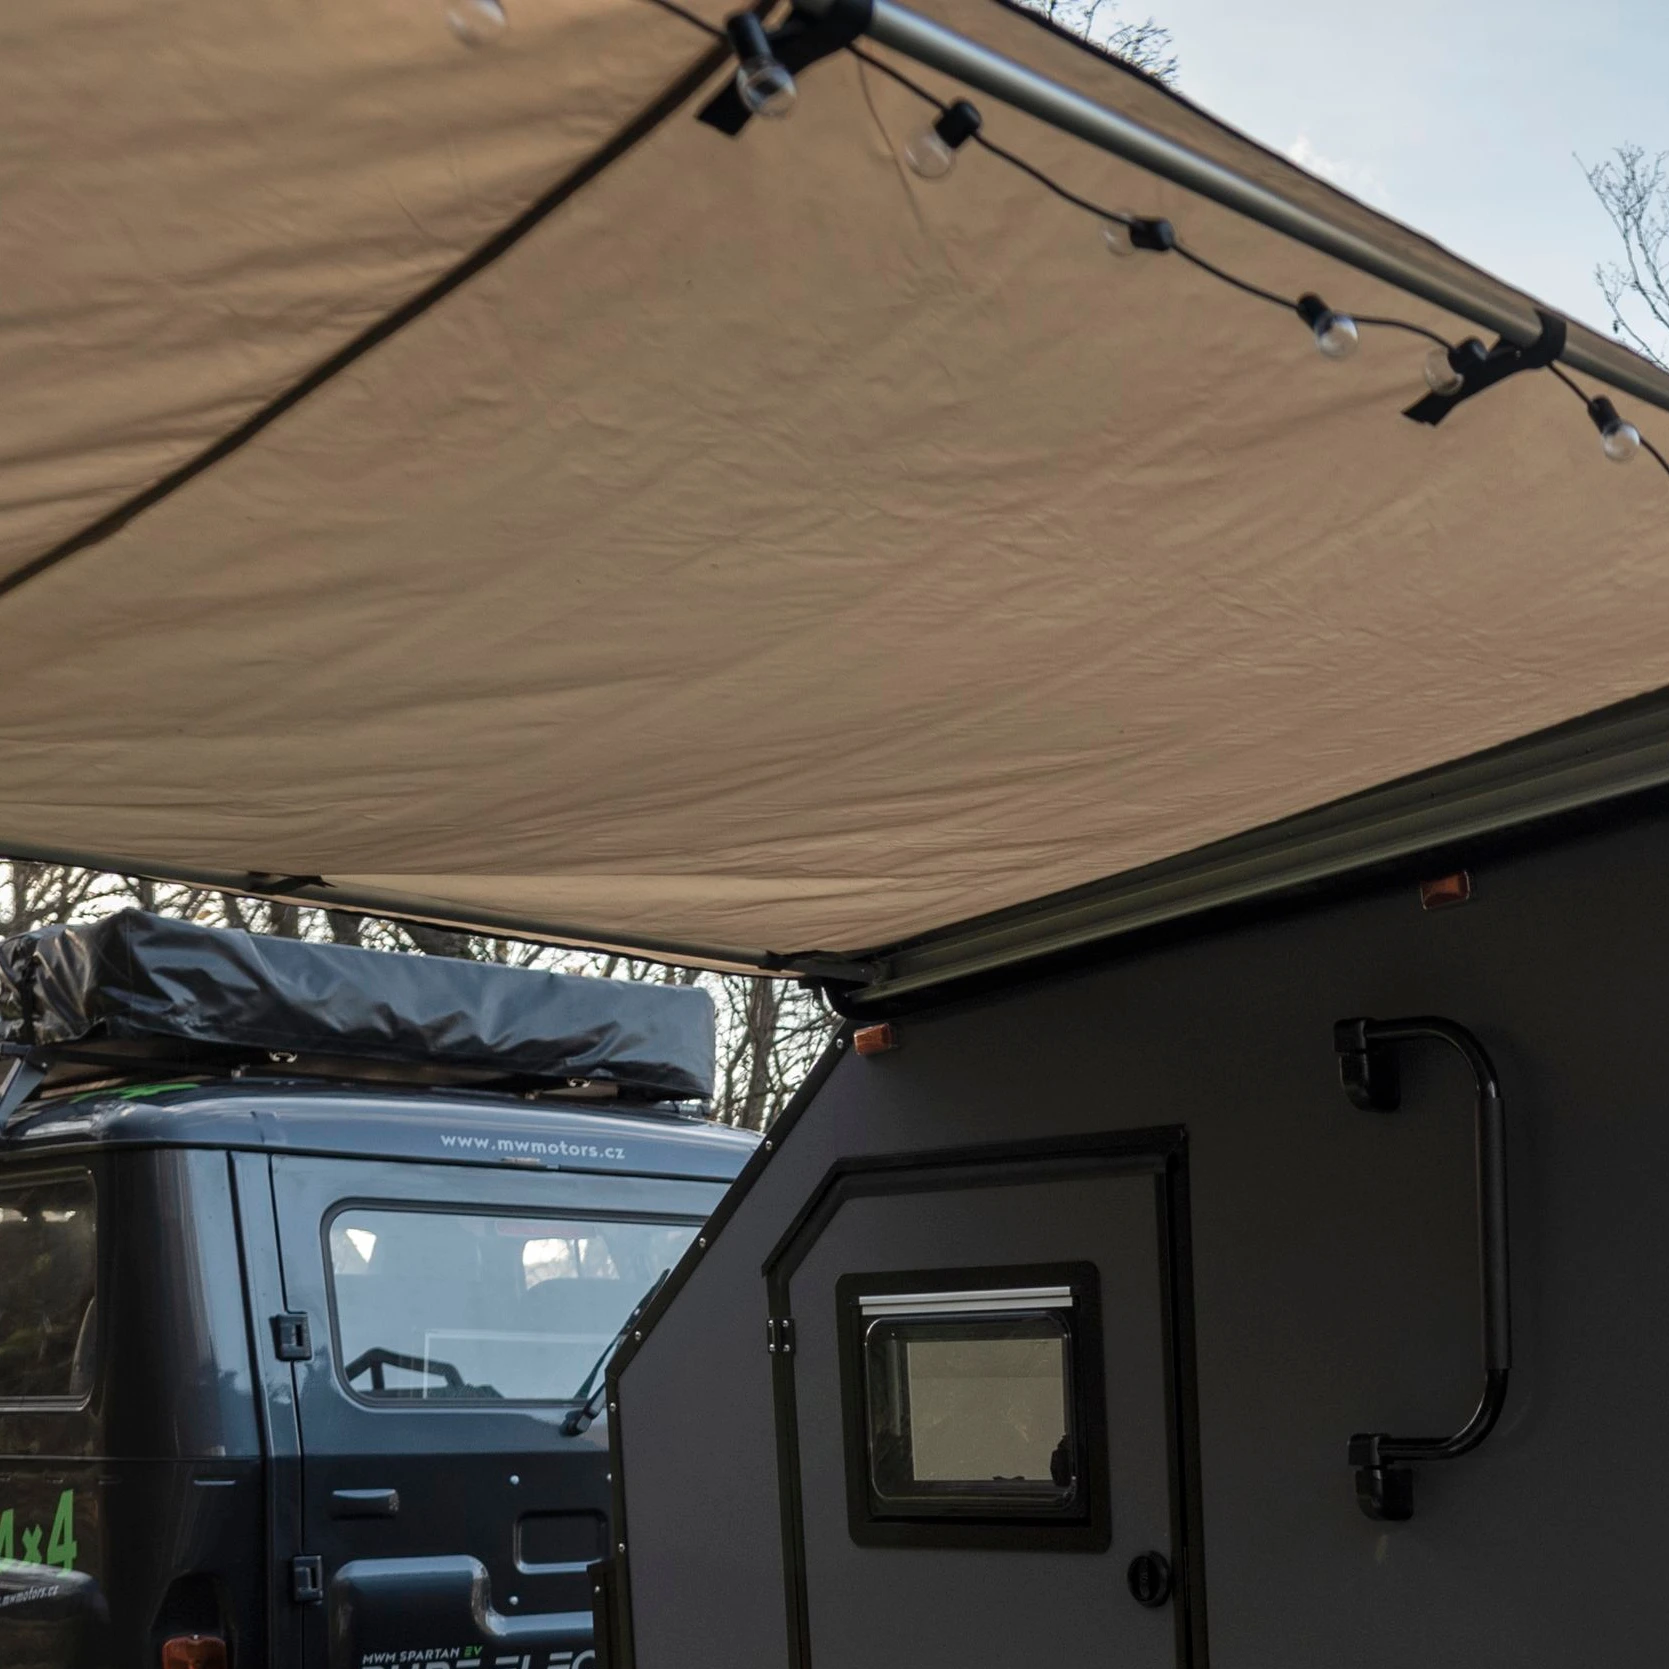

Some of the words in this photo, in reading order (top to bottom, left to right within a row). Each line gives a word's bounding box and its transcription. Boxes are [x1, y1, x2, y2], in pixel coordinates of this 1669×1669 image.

[440, 1134, 626, 1160] www.mwmotors.cz
[362, 1652, 396, 1665] MWM
[399, 1646, 461, 1662] SPARTAN
[463, 1645, 483, 1658] EV
